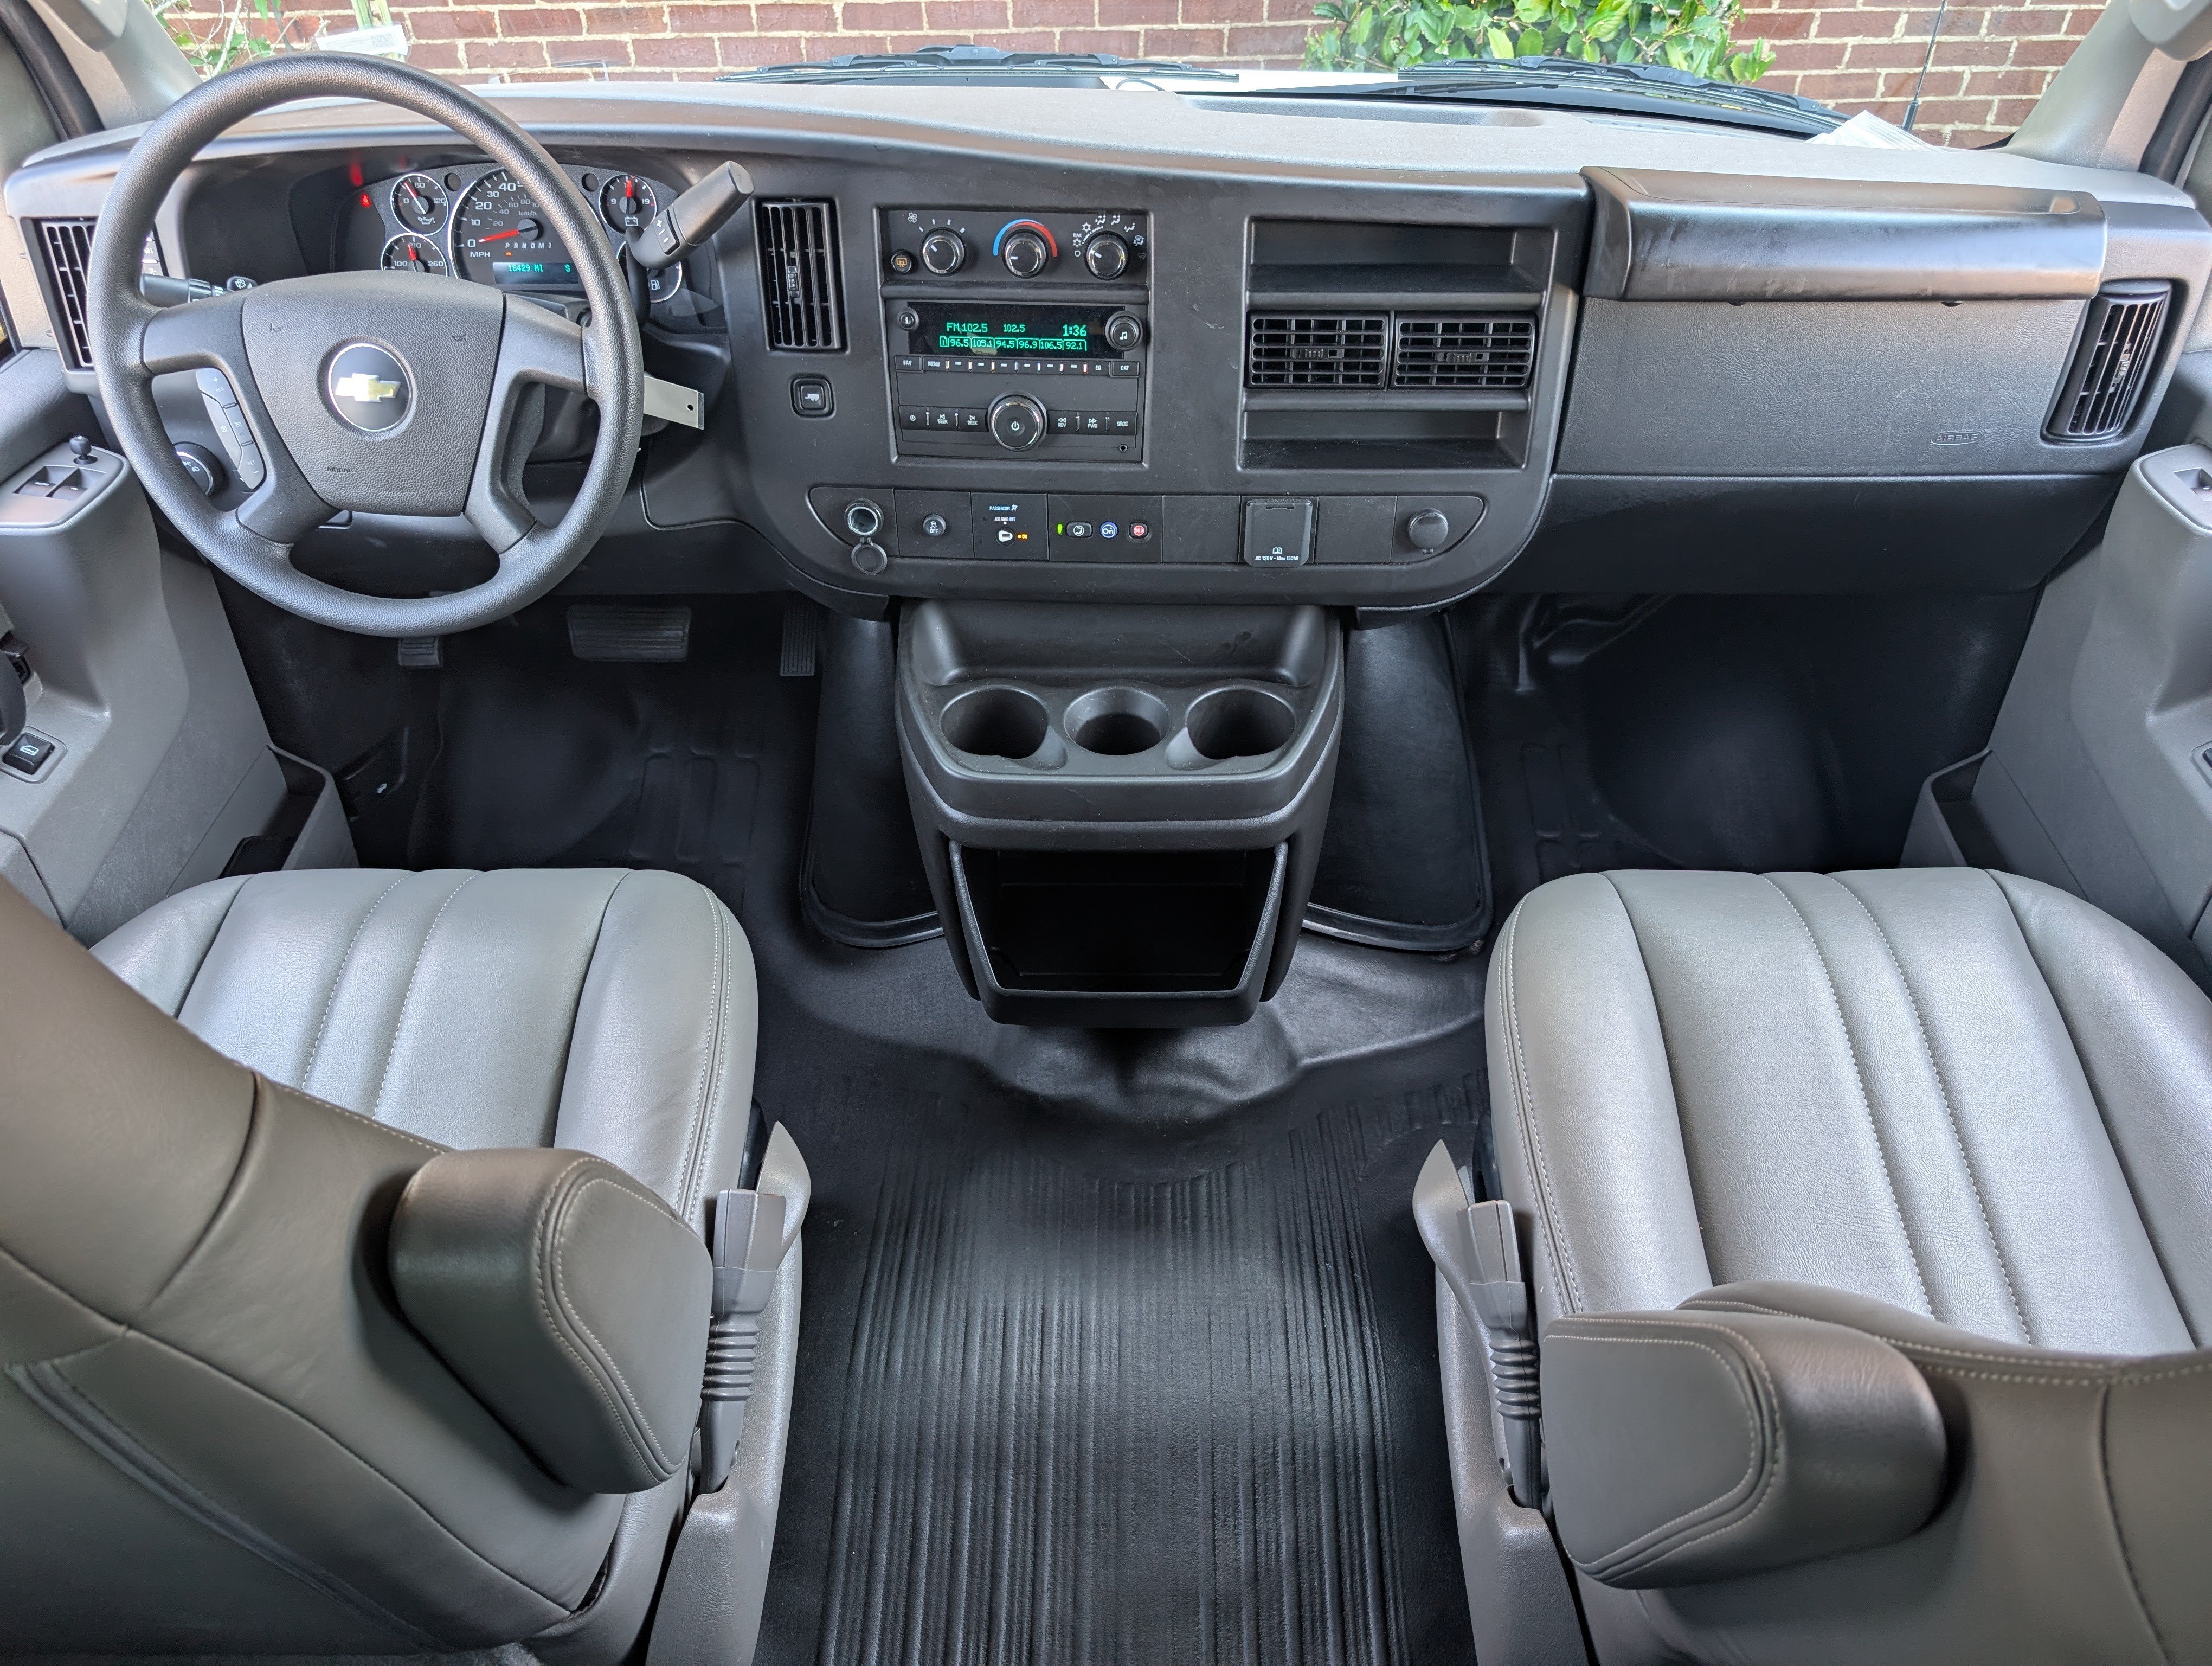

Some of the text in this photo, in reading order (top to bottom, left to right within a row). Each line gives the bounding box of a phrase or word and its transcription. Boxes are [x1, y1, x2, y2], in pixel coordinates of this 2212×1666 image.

[498, 182, 516, 191] 40
[475, 201, 492, 210] 20
[467, 239, 476, 247] 0
[1003, 324, 1025, 332] 102.5
[1063, 324, 1087, 337] 1:36
[950, 339, 969, 347] 96.5
[973, 339, 993, 348] 105.1
[996, 340, 1015, 348] 94.5
[1019, 341, 1038, 349] 96.9
[1041, 342, 1062, 350] 106.5
[1936, 434, 1978, 442] AIRBAG
